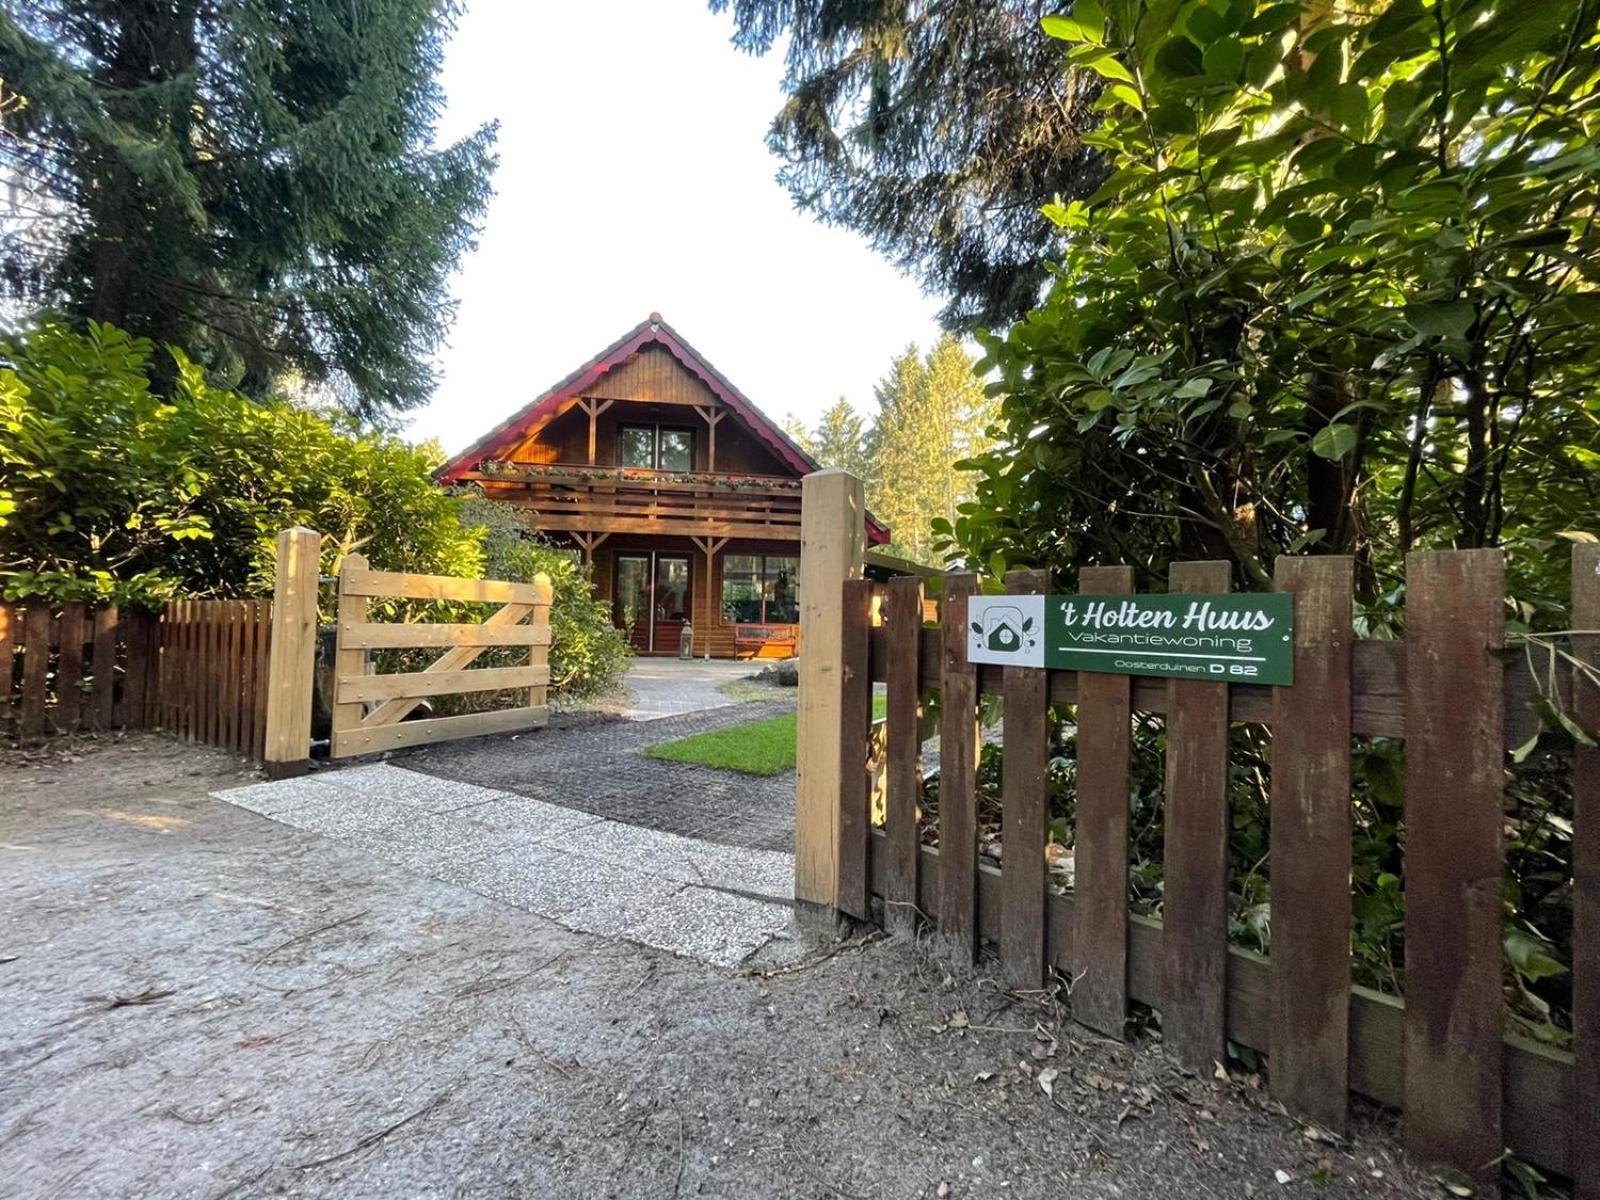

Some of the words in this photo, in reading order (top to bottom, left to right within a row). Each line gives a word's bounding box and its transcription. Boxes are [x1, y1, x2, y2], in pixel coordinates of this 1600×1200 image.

[1082, 601, 1176, 629] Holten
[1182, 601, 1275, 632] Huus
[1068, 631, 1253, 653] Vakantiewoning
[1114, 659, 1206, 673] Oosterduinen
[1209, 663, 1226, 675] D
[1229, 664, 1259, 676] 82
